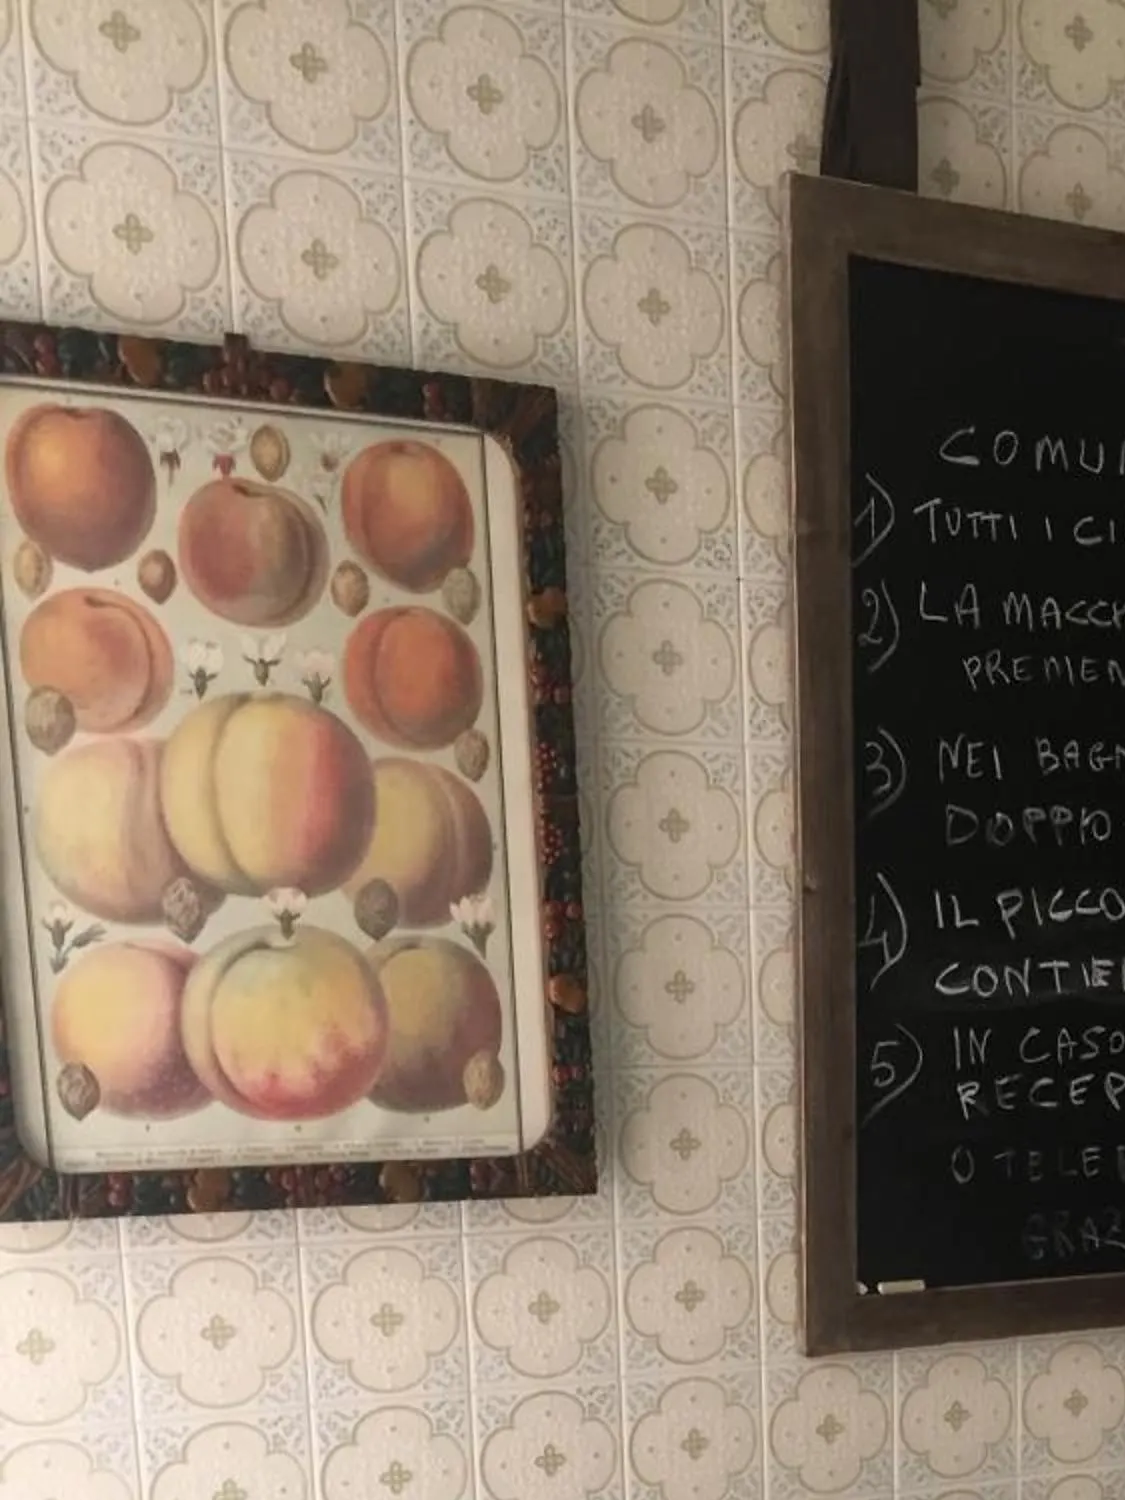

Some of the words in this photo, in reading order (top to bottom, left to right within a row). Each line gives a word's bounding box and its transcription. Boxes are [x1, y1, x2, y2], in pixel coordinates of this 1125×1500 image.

[912, 497, 1019, 544] TUTTI
[1044, 516, 1054, 541] I
[857, 579, 900, 673] 2)
[918, 579, 981, 630] LA
[863, 725, 908, 819] 3)
[937, 733, 1004, 783] NEI
[945, 803, 1112, 848] DOPPIO
[933, 889, 981, 929] IL
[861, 1022, 924, 1128] 5)
[953, 1026, 993, 1071] IN
